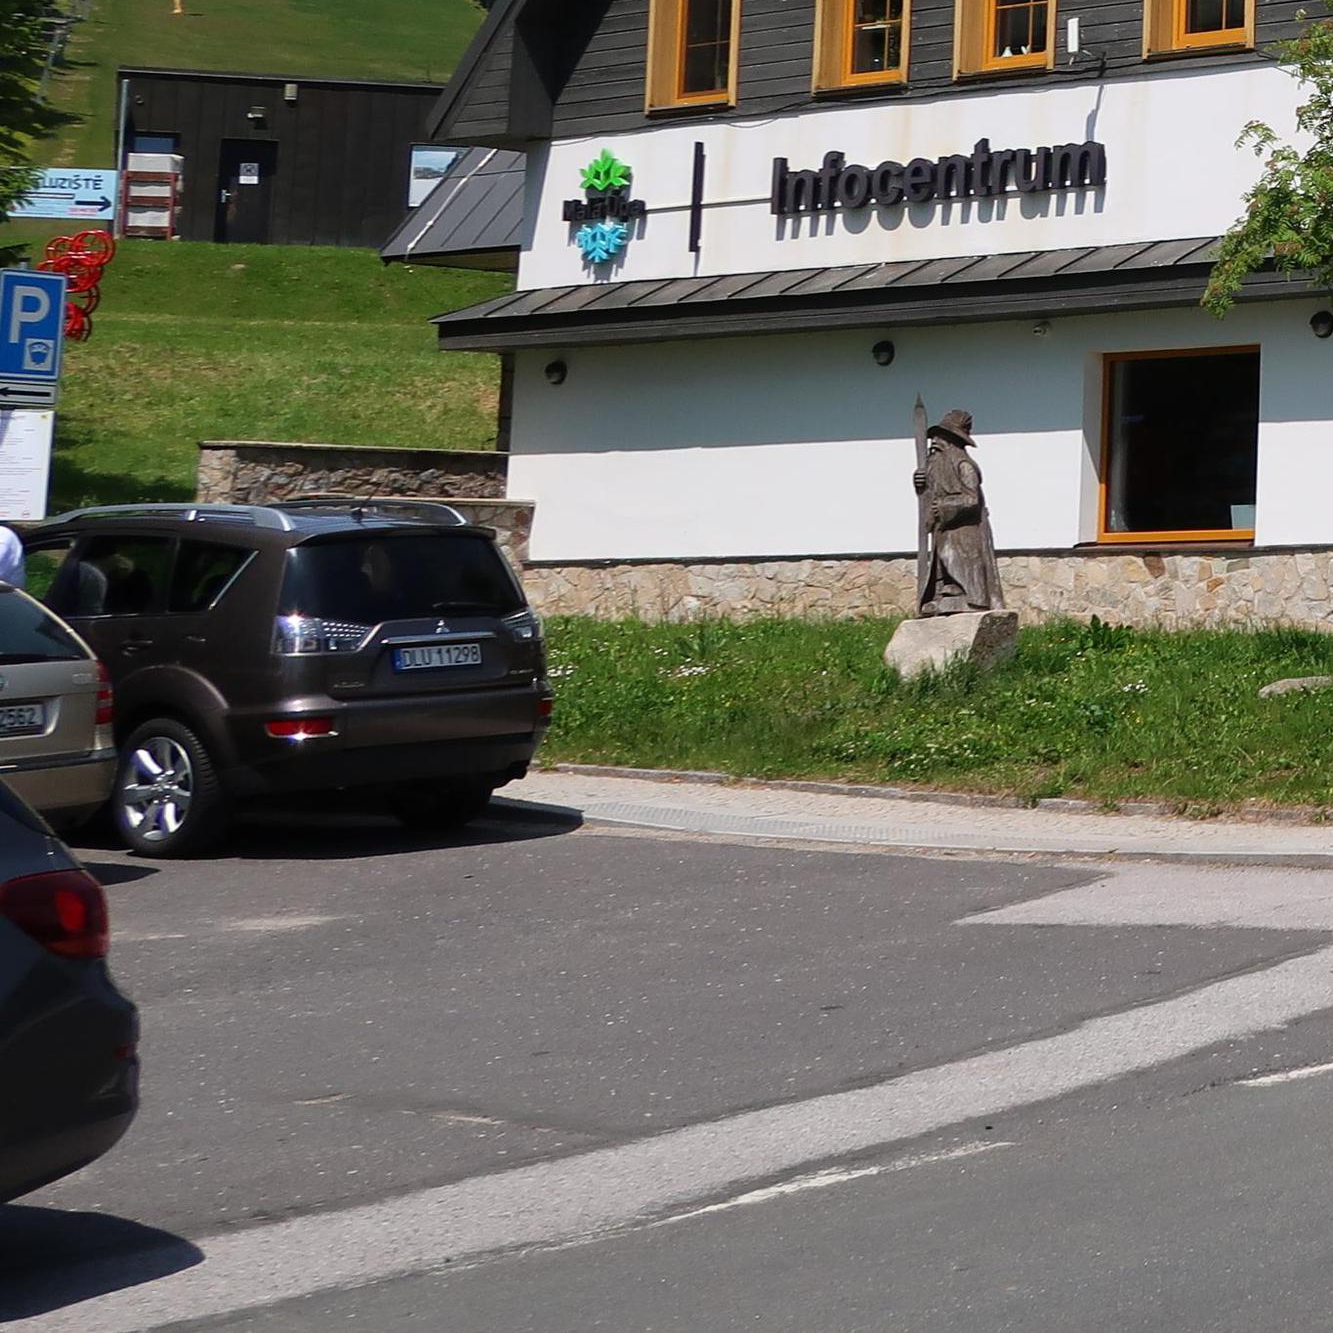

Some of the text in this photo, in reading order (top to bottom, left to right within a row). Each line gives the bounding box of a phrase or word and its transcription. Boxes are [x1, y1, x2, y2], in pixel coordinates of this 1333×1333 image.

[770, 138, 1107, 215] Infocentrum
[8, 285, 51, 344] P
[402, 645, 479, 667] DLU 11298
